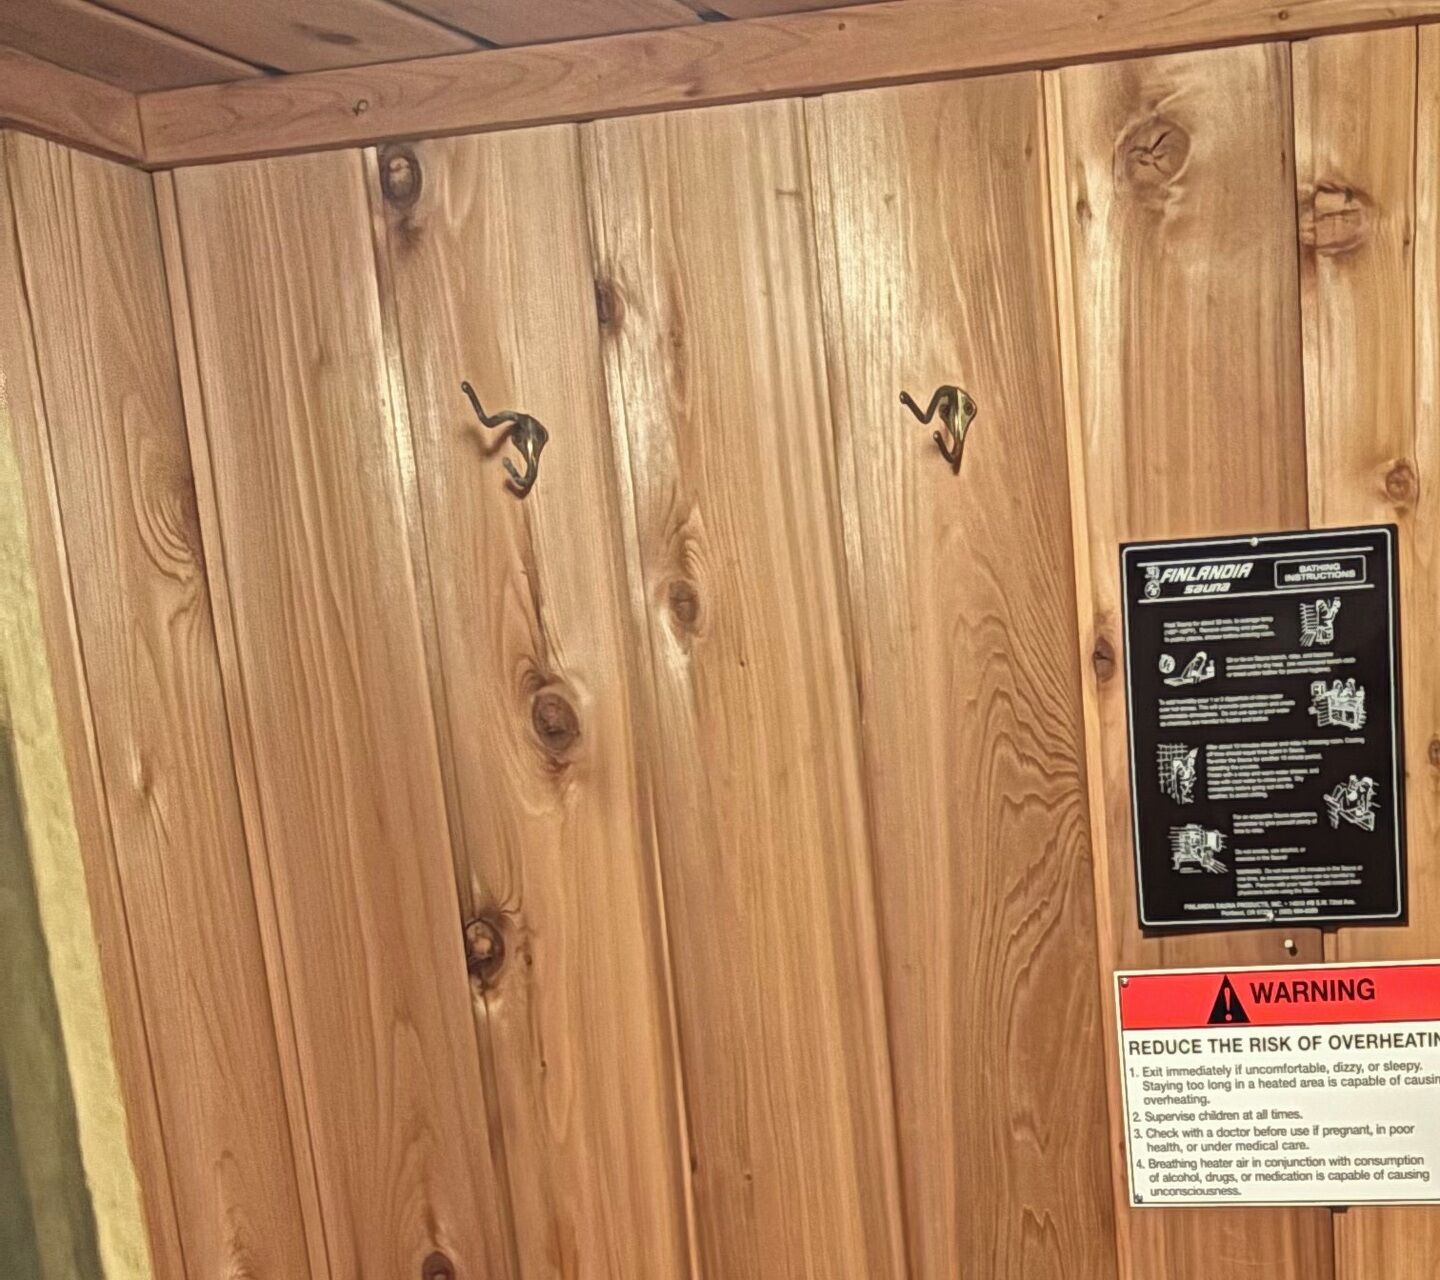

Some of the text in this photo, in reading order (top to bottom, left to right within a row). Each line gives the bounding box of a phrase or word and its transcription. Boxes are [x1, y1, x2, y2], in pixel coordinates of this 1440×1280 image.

[1160, 563, 1254, 583] FINLANDIA
[1299, 563, 1340, 572] BATHING
[1285, 570, 1356, 581] INSTRUCTIONS
[1184, 583, 1231, 594] sauna
[1250, 978, 1375, 1004] WARNING
[1128, 1039, 1202, 1055] REDUCE
[1207, 1038, 1243, 1053] THE
[1249, 1036, 1292, 1052] RISK
[1298, 1036, 1322, 1050] OF
[1129, 1061, 1423, 1078] 1. Exit immediately if uncomfortable, dizzy, or sleepy.
[1143, 1081, 1183, 1093] Staying
[1187, 1081, 1205, 1090] too
[1208, 1080, 1232, 1091] long
[1235, 1079, 1245, 1089] in
[1248, 1080, 1255, 1088] a
[1258, 1078, 1297, 1088] heated
[1300, 1078, 1325, 1087] area
[1328, 1077, 1337, 1087] is
[1341, 1075, 1386, 1088] capable
[1389, 1075, 1401, 1085] of
[1143, 1095, 1210, 1106] overheating.
[1133, 1110, 1303, 1123] 2. Supervise children at all times.
[1134, 1124, 1415, 1139] 3. Check with a doctor before use if pregnant, in poor
[1147, 1141, 1309, 1153] health, or under medical care.
[1136, 1155, 1424, 1170] 4. Breathing heater air in conjunction with consumption
[1149, 1169, 1430, 1184] of alcohol, drugs, or medication is capable of causing
[1150, 1186, 1241, 1196] unconsciousness.
